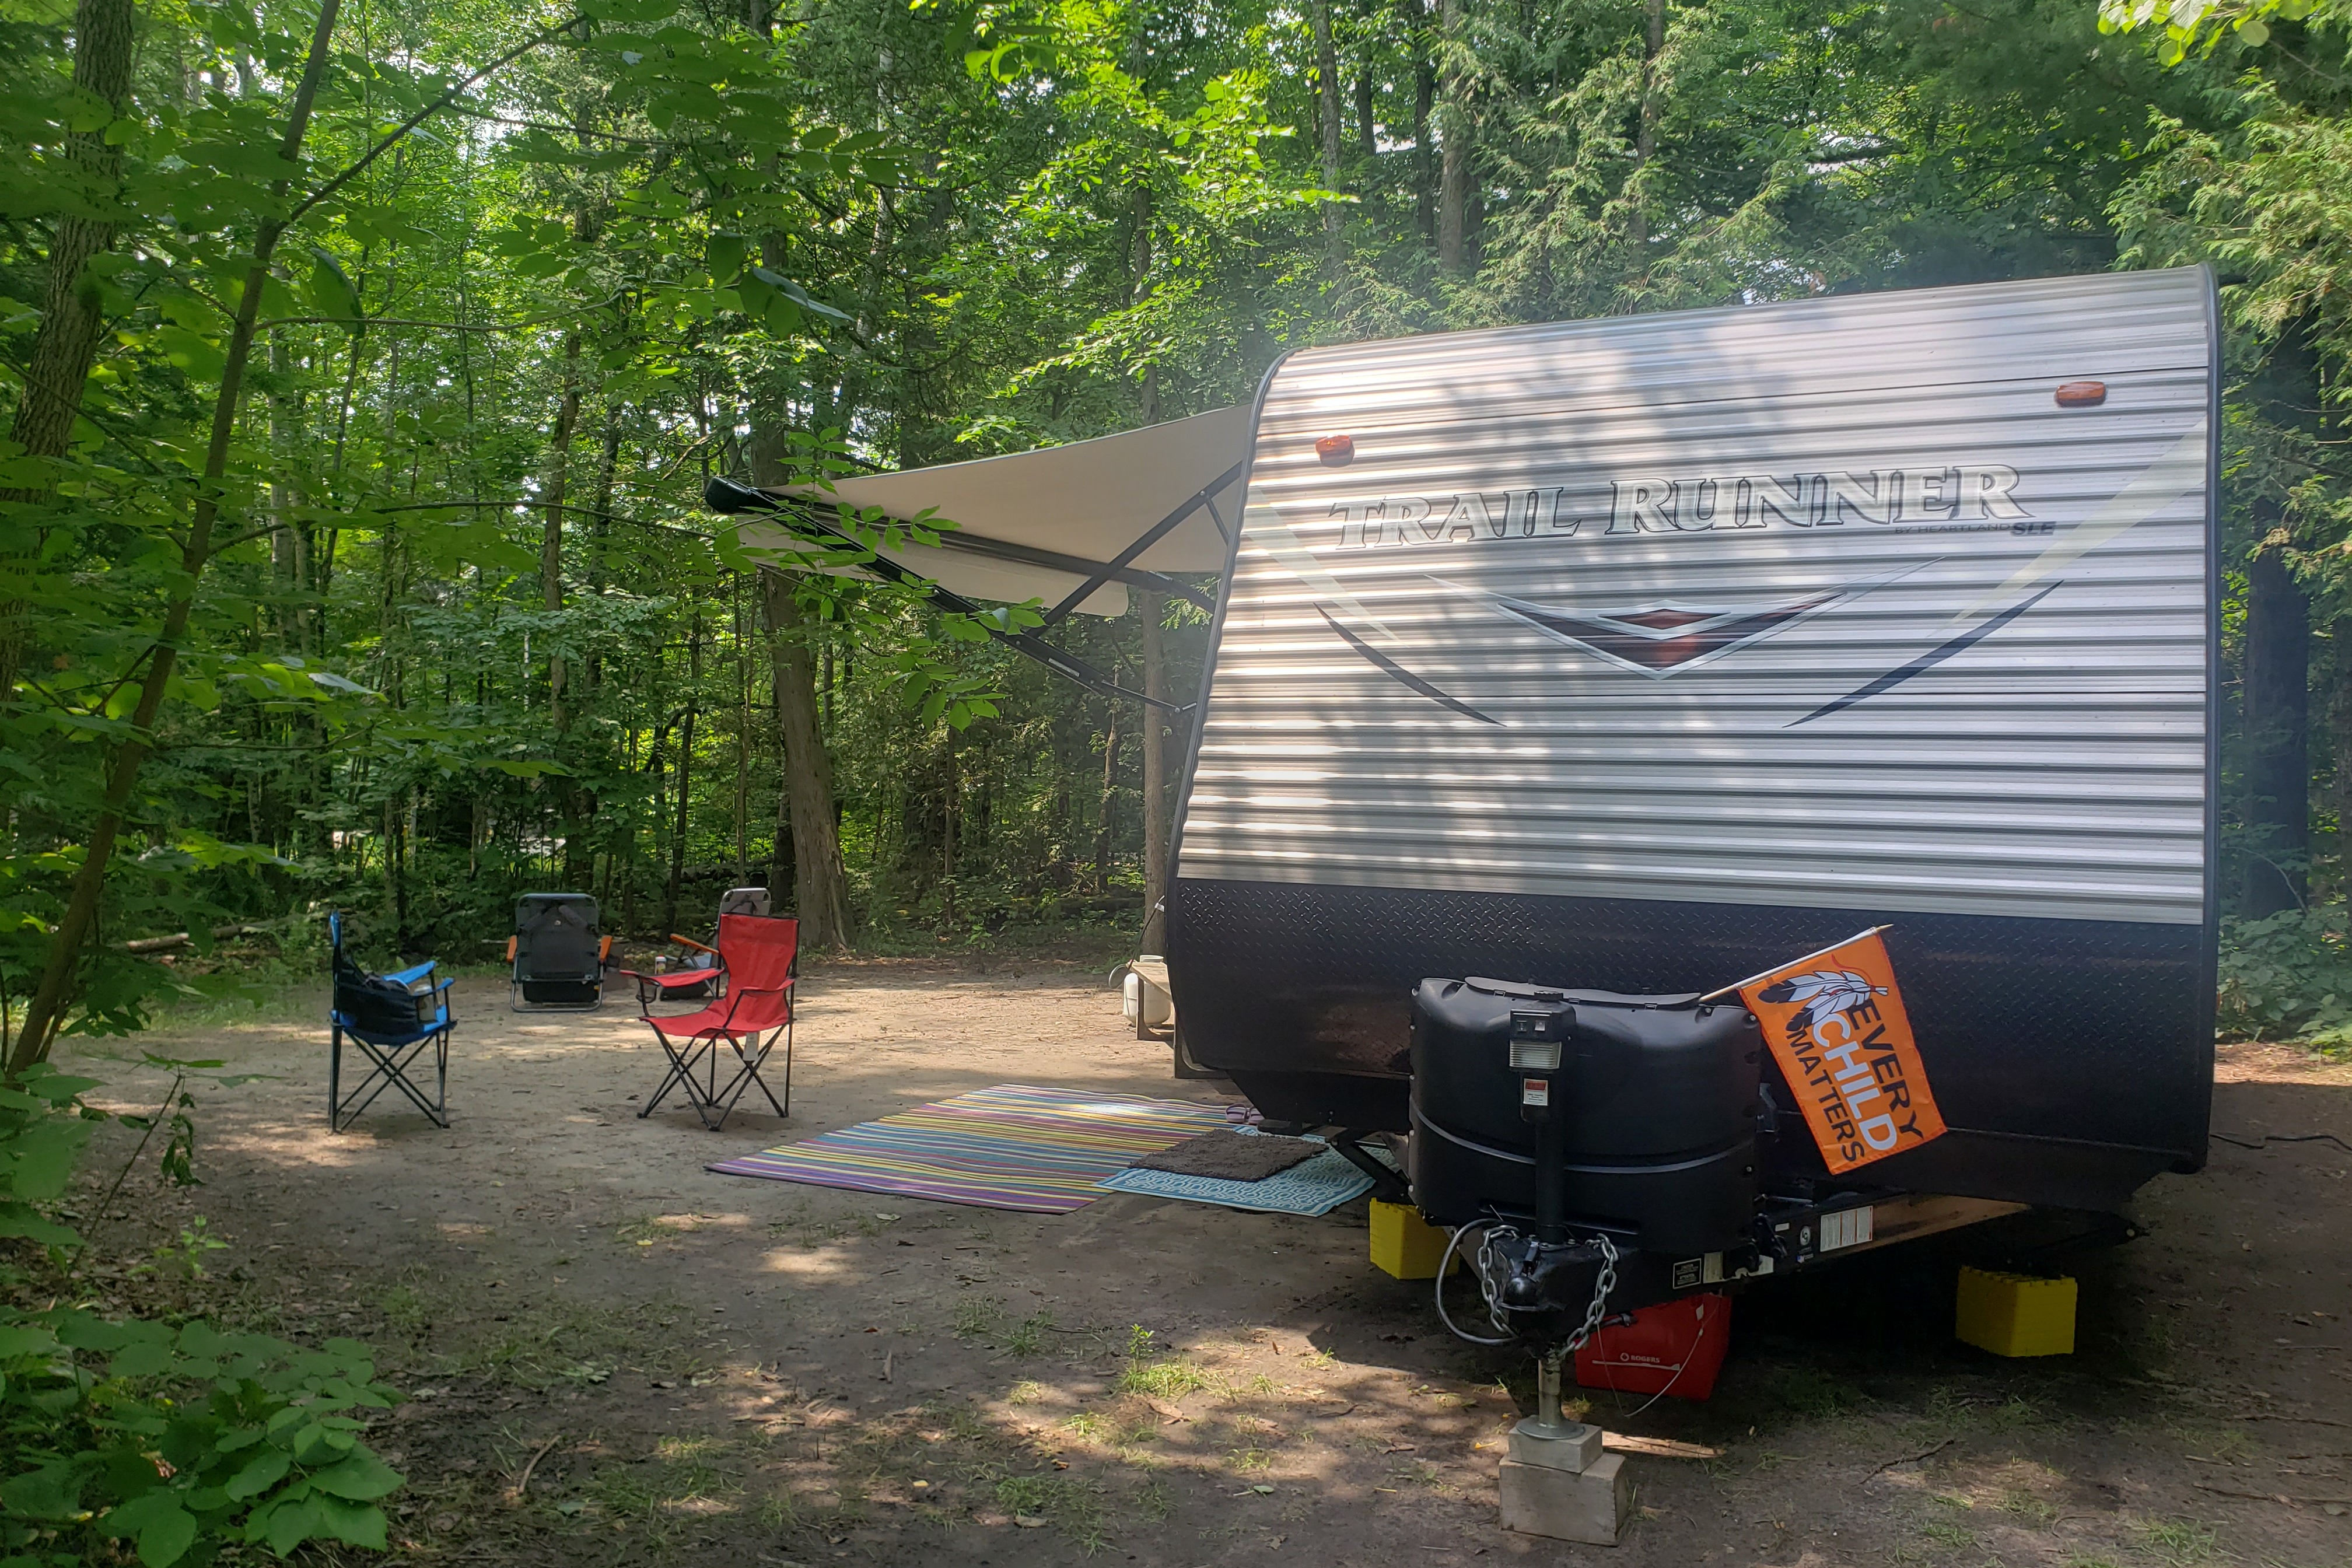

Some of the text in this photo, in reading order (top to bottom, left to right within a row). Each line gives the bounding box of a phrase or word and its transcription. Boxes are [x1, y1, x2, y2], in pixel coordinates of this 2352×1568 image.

[1328, 464, 2036, 550] TRAIL RUNNER
[1917, 523, 2011, 533] HEARTLAND
[2011, 521, 2057, 536] SLE
[1786, 1029, 1865, 1162] MATTERS
[1812, 1013, 1898, 1150] CHILD
[1847, 998, 1924, 1139] EVERY
